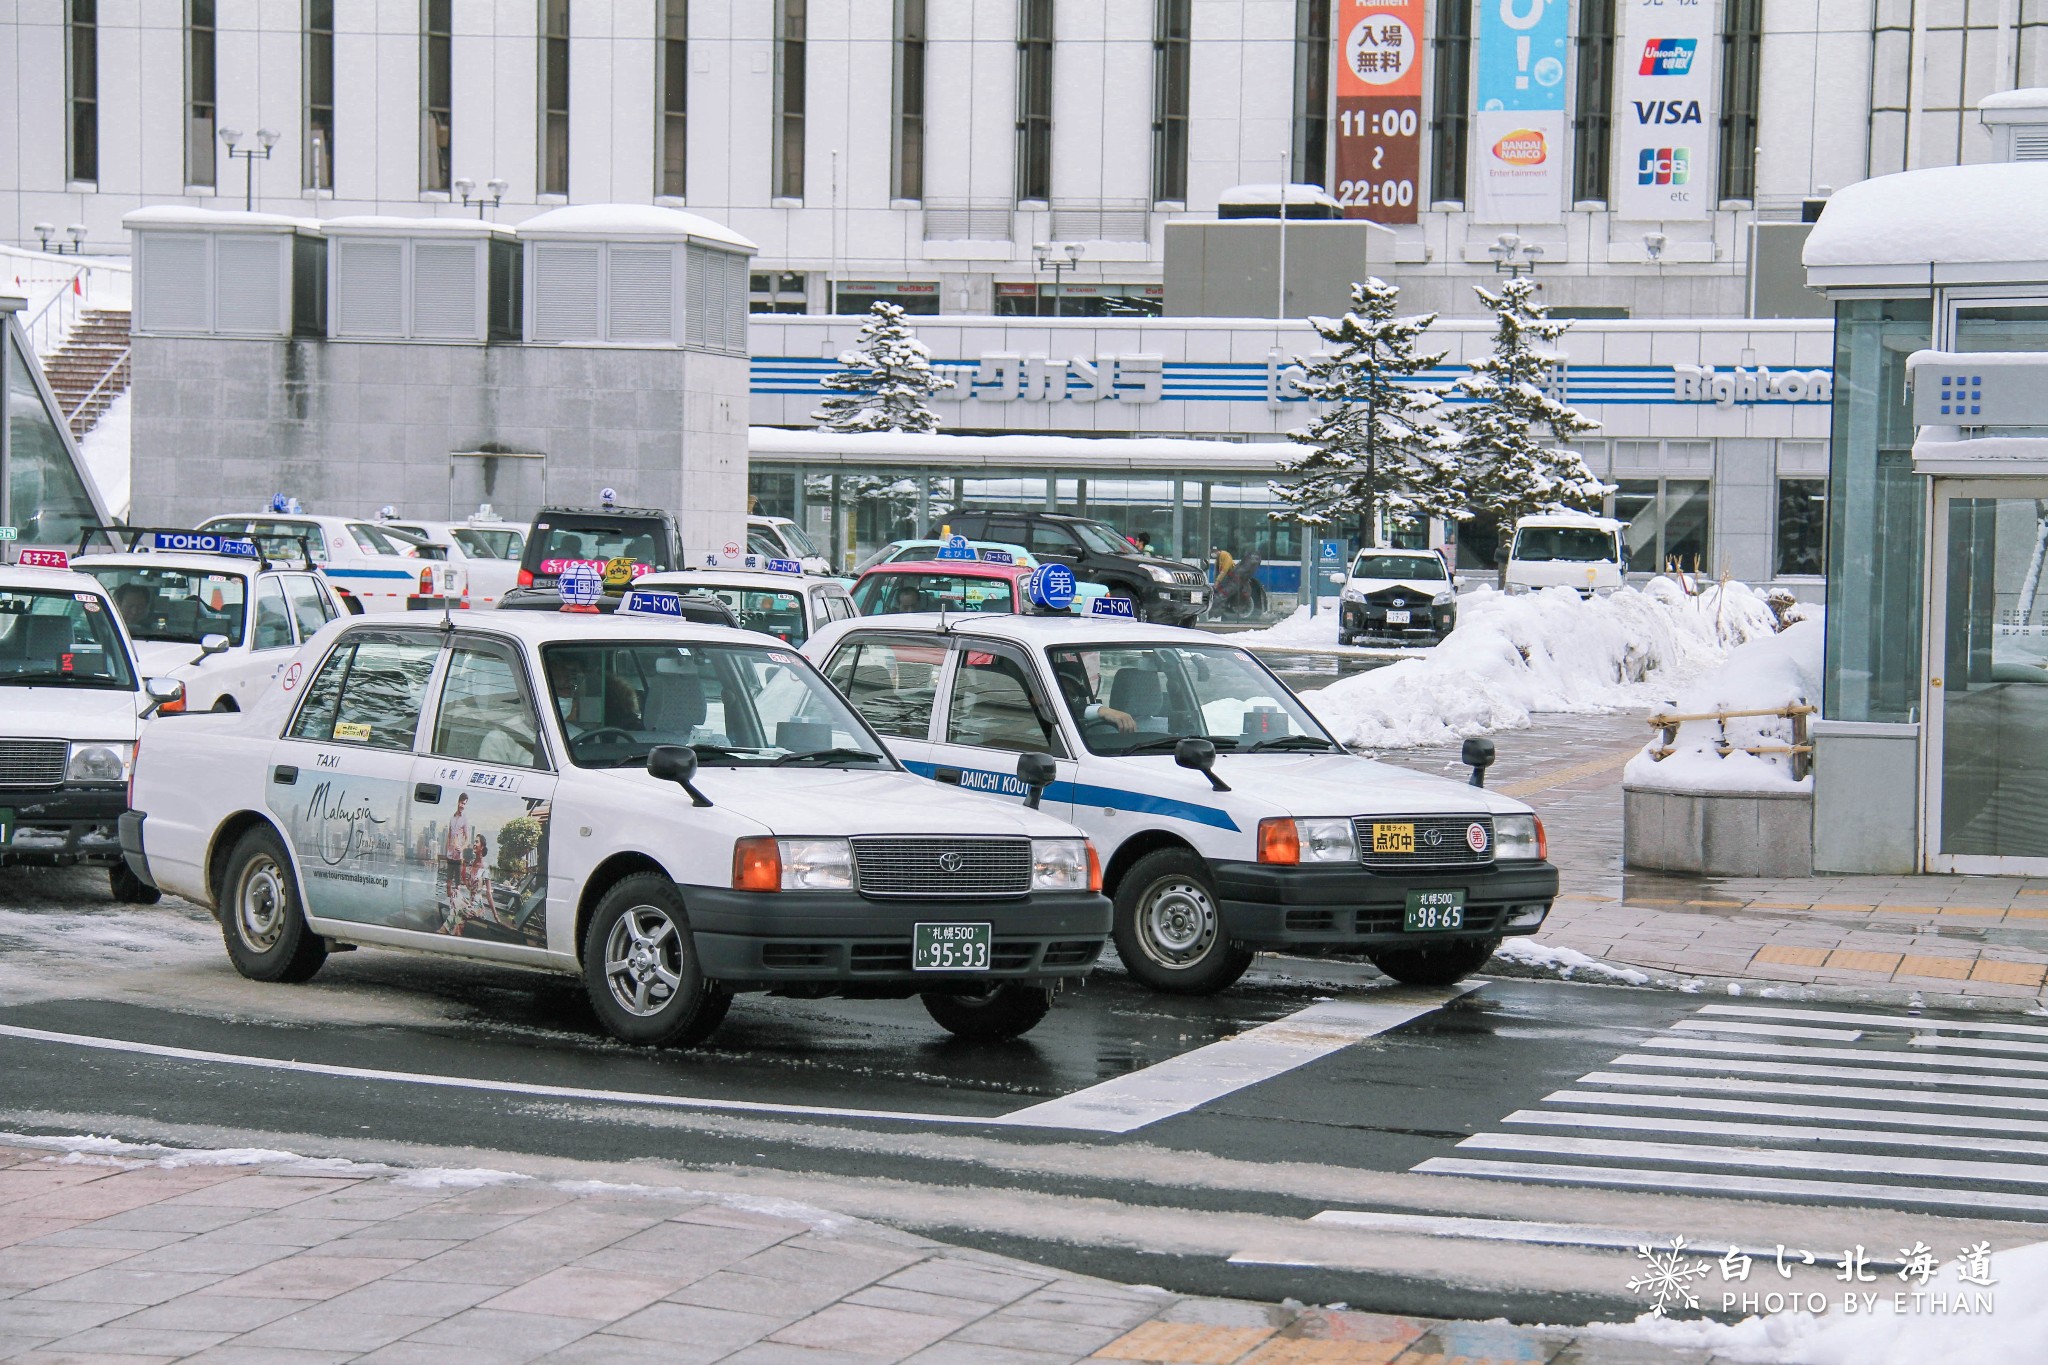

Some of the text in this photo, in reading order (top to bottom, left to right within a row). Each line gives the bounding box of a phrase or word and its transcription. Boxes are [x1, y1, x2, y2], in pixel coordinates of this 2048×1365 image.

[1357, 25, 1402, 47] 入場
[1644, 46, 1694, 60] UnionPay
[1357, 51, 1402, 73] 無料
[1631, 100, 1702, 124] VISA
[1341, 109, 1417, 136] 11:00
[1501, 140, 1541, 150] BANDAI
[1501, 149, 1541, 159] NAMCO
[1489, 169, 1548, 178] Entertainment
[1638, 159, 1688, 174] JCB
[1338, 180, 1414, 207] 22:00
[1670, 191, 1690, 201] etc
[160, 534, 216, 549] TOHO
[223, 542, 255, 555] カードOK
[950, 539, 964, 548] SK
[22, 551, 66, 566] 電子マネー
[944, 550, 971, 559] 北びし
[986, 552, 1011, 562] カードOK
[770, 560, 799, 572] カードOK
[1049, 570, 1072, 601] 第一
[632, 594, 677, 612] カードOK
[1095, 599, 1130, 613] カードOK
[316, 753, 341, 768] TAXI
[498, 776, 515, 789] 21
[960, 770, 1000, 791] DAIICHI
[306, 780, 386, 866] Malaysia
[1376, 832, 1413, 851] 点灯中
[312, 869, 389, 888] www.tourismmalaysia.or.jp
[1417, 905, 1462, 928] 98-65
[929, 942, 986, 967] 95-93
